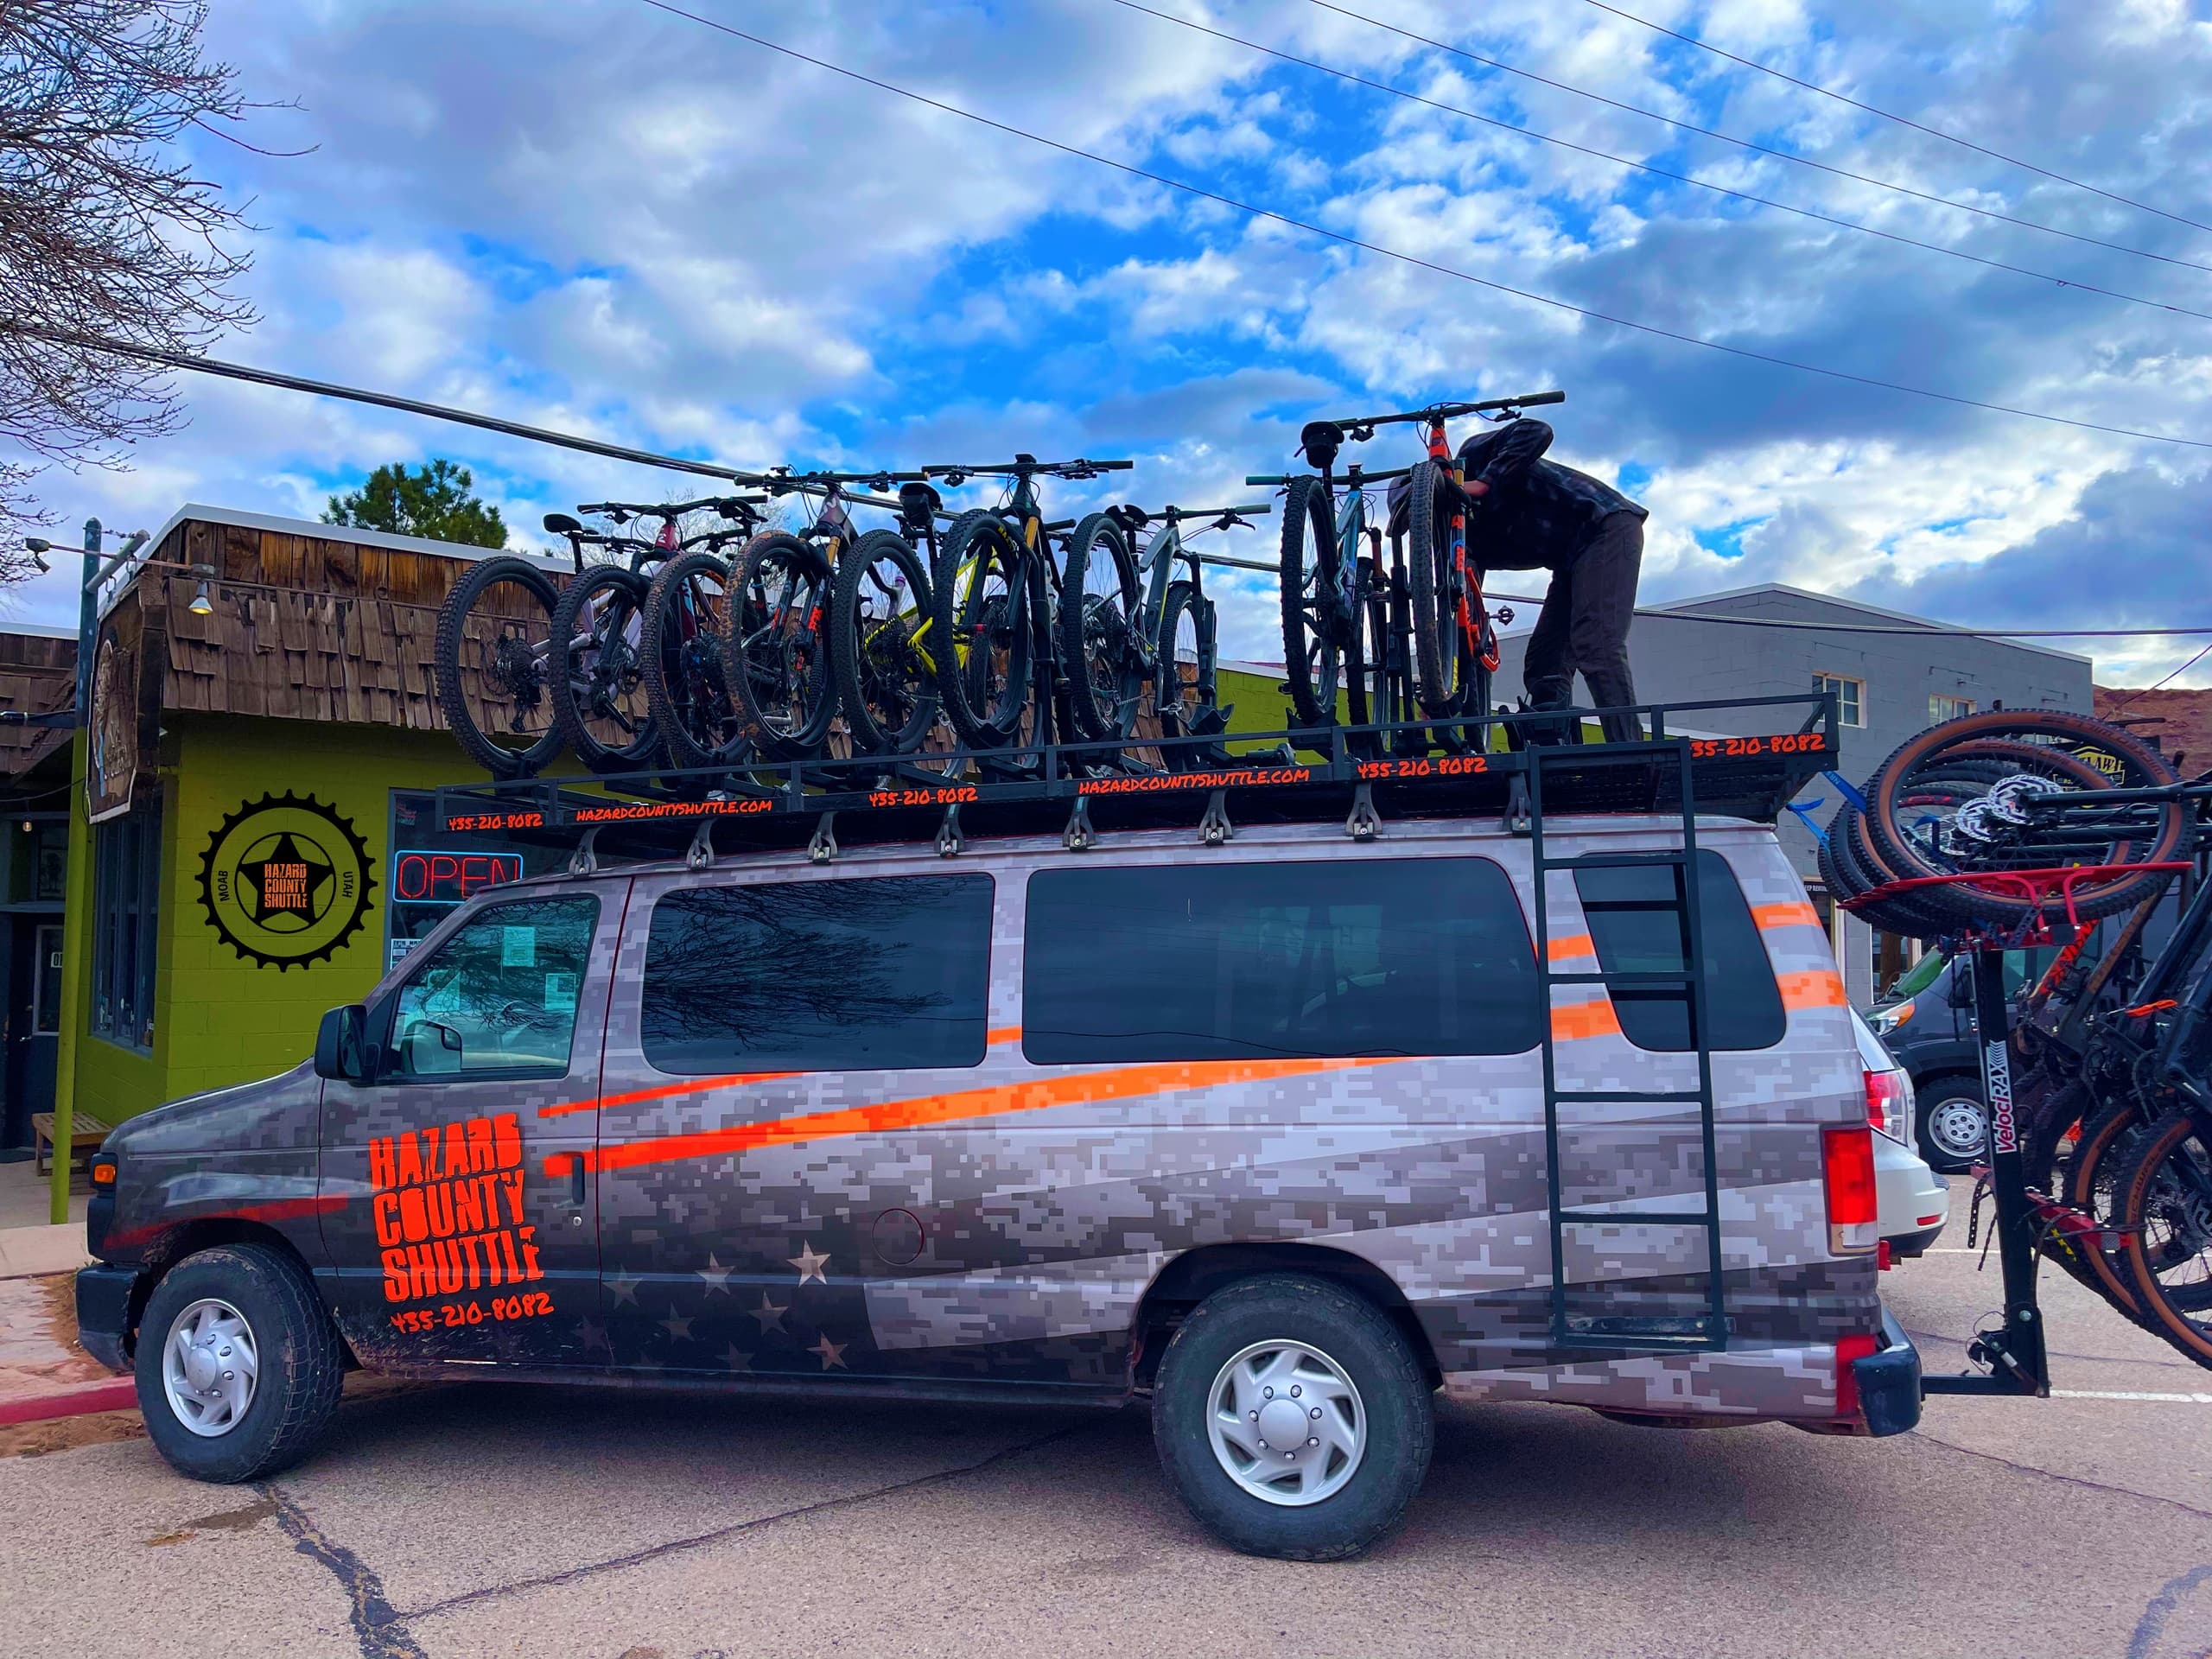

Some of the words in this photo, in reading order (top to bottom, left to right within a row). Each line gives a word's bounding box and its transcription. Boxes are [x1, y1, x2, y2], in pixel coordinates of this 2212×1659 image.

[1691, 733, 1826, 758] 35-210-8082
[1357, 756, 1488, 779] 435-210-8082
[1078, 768, 1310, 795] HAZARDCOUNTYSHUTTLE.COM
[868, 786, 978, 807] 435-210-8082
[448, 813, 543, 831] 435-210-8082
[576, 800, 772, 822] HAZARDCOUNTYSHUTTLE.COM
[264, 864, 307, 879] HAZARD
[399, 855, 518, 899] OPEN
[218, 870, 231, 901] MOAB
[264, 879, 307, 893] COUNTY
[342, 871, 353, 899] UTAH
[264, 893, 308, 908] SHUTTLE
[368, 1112, 522, 1192] HAZARD
[373, 1168, 525, 1248] COUNTY
[381, 1225, 544, 1303] SHUTTLE
[391, 1293, 555, 1334] 435-210-8082
